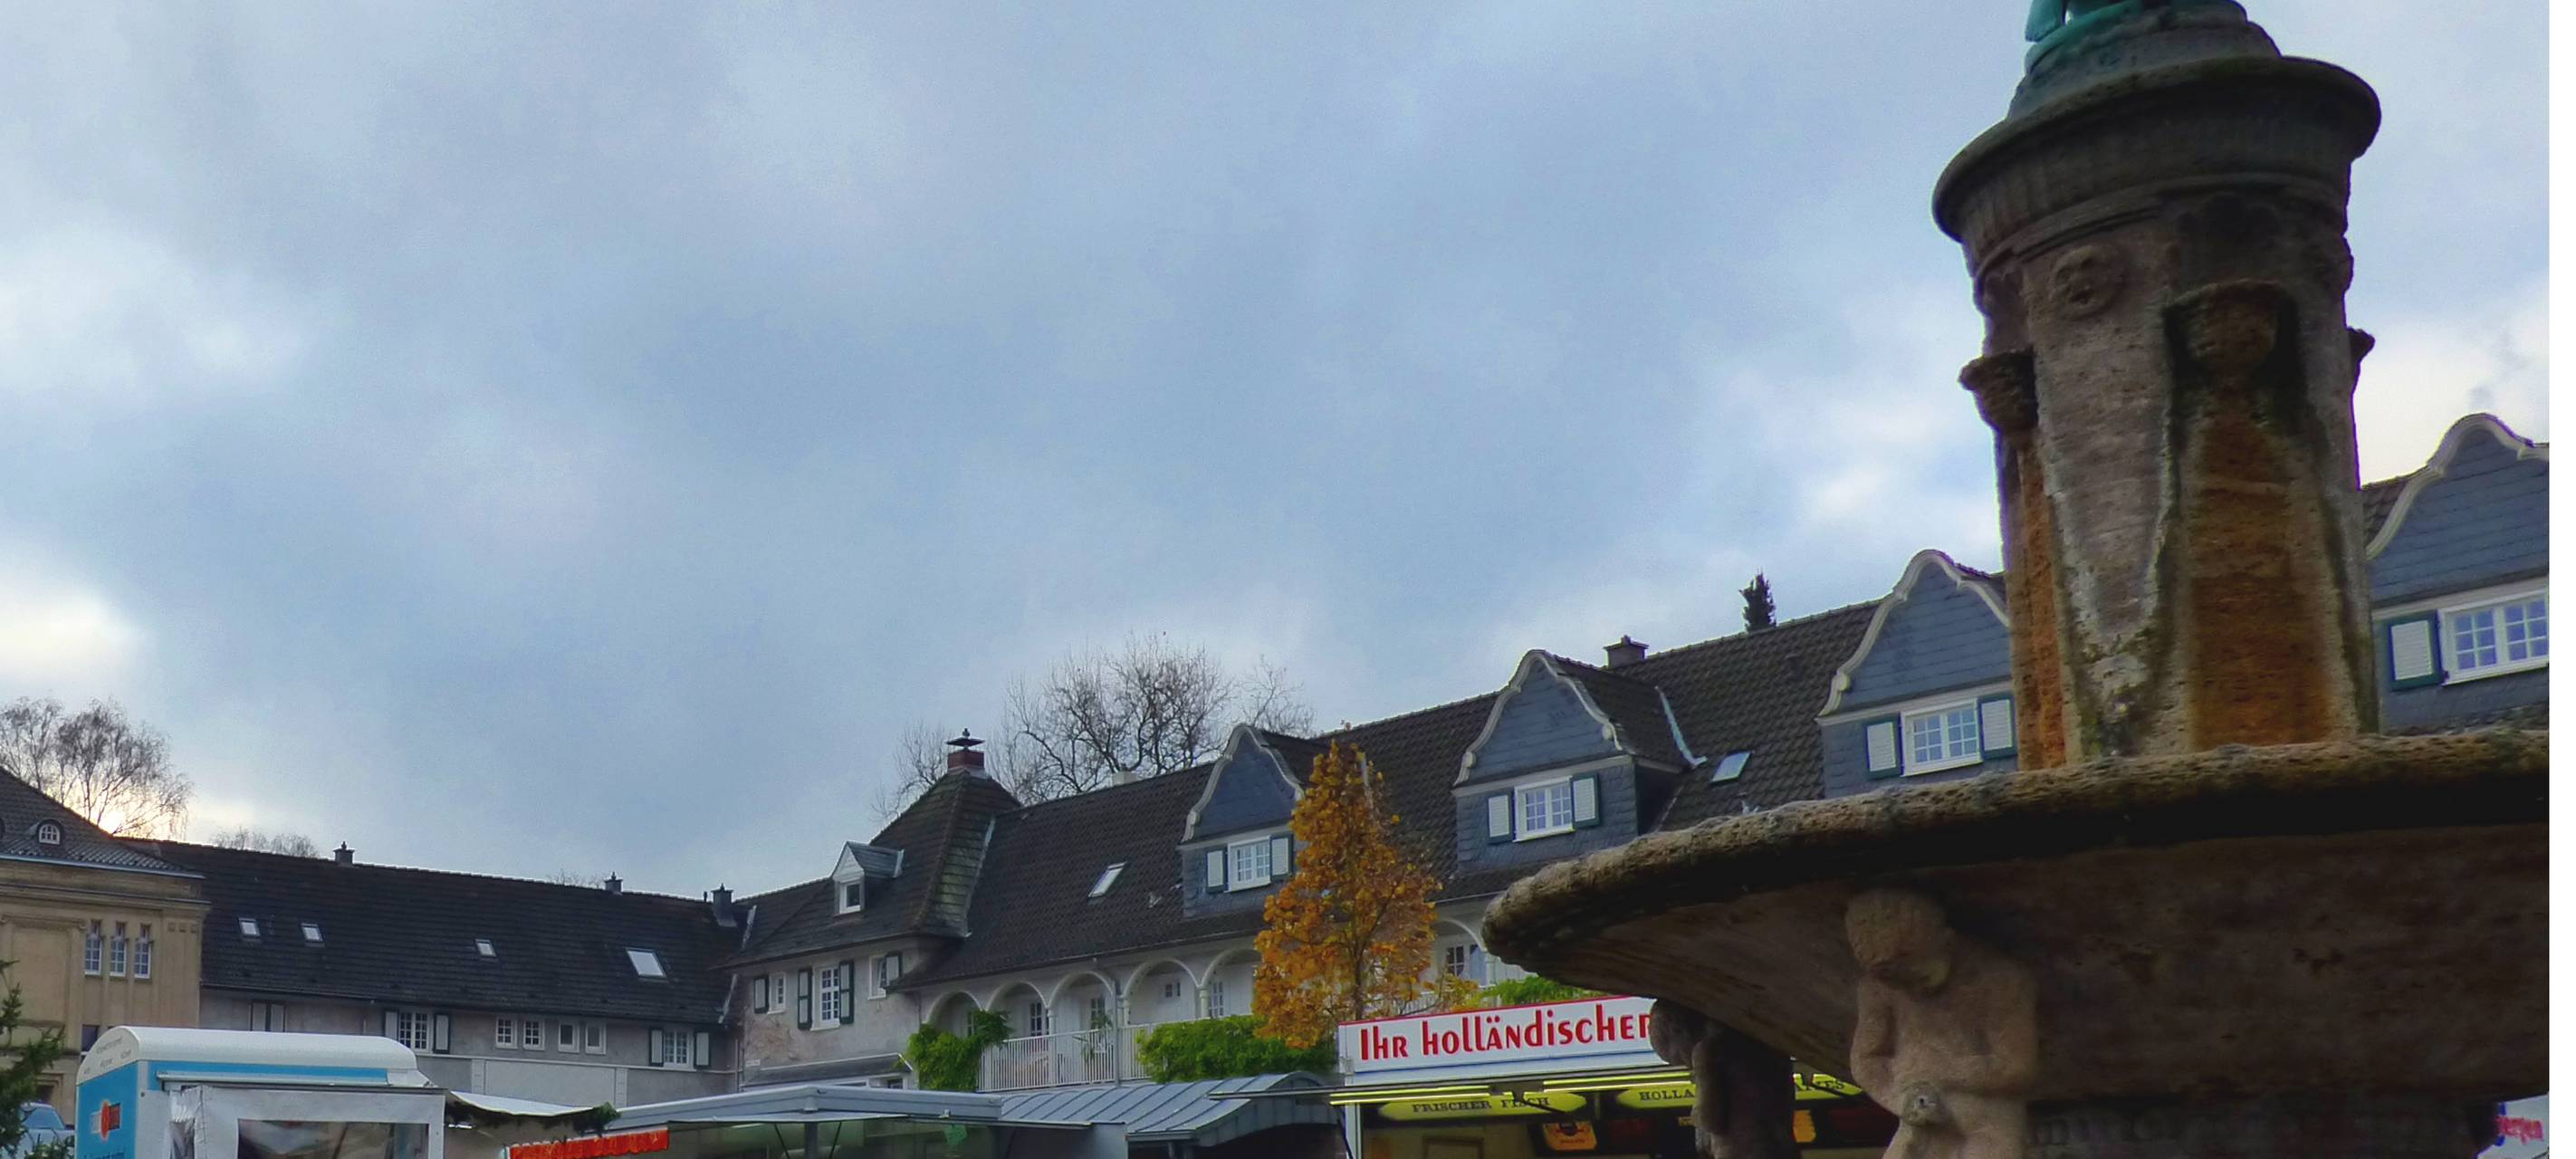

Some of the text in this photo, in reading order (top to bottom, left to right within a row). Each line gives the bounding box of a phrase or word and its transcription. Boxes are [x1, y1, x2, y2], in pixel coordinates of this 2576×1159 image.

[1360, 1025, 1409, 1061] Ihr
[1638, 1088, 1695, 1101] HOLLA
[1412, 1100, 1493, 1113] FRISCHER
